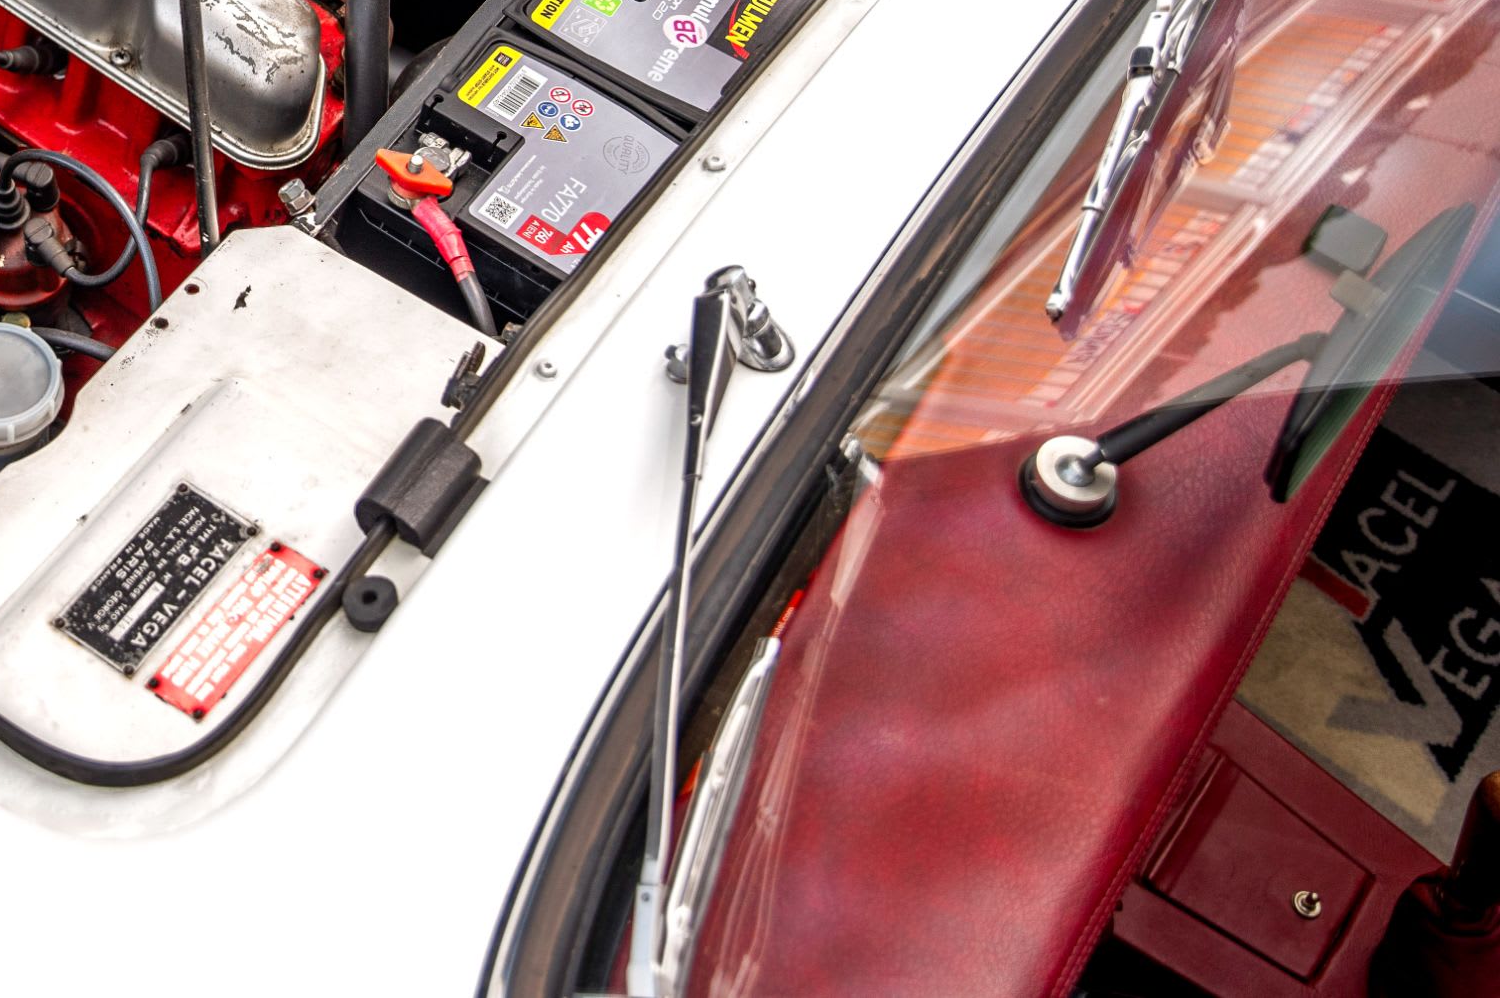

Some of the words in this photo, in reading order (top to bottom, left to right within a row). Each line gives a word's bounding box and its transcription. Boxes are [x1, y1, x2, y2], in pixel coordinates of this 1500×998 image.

[675, 20, 697, 49] 2B
[647, 43, 684, 82] reme
[617, 135, 634, 174] QUALITY
[539, 176, 587, 224] FA770
[532, 226, 554, 244] 760
[559, 240, 576, 255] Ah
[571, 223, 604, 251] 77
[137, 514, 160, 540] MADE
[177, 504, 199, 528] FACEL
[185, 514, 206, 536] POIDS
[165, 535, 186, 557] TOTAL
[196, 521, 216, 543] TYPE
[113, 537, 154, 581] PARIS
[124, 542, 135, 554] IN
[182, 536, 233, 590] FACEL
[89, 555, 122, 592] FRANCE
[121, 559, 150, 590] AVENUE
[128, 569, 155, 599] CHARGE
[93, 588, 123, 621] GEORGE
[129, 601, 178, 649] VEGA
[1326, 577, 1500, 748] VEG
